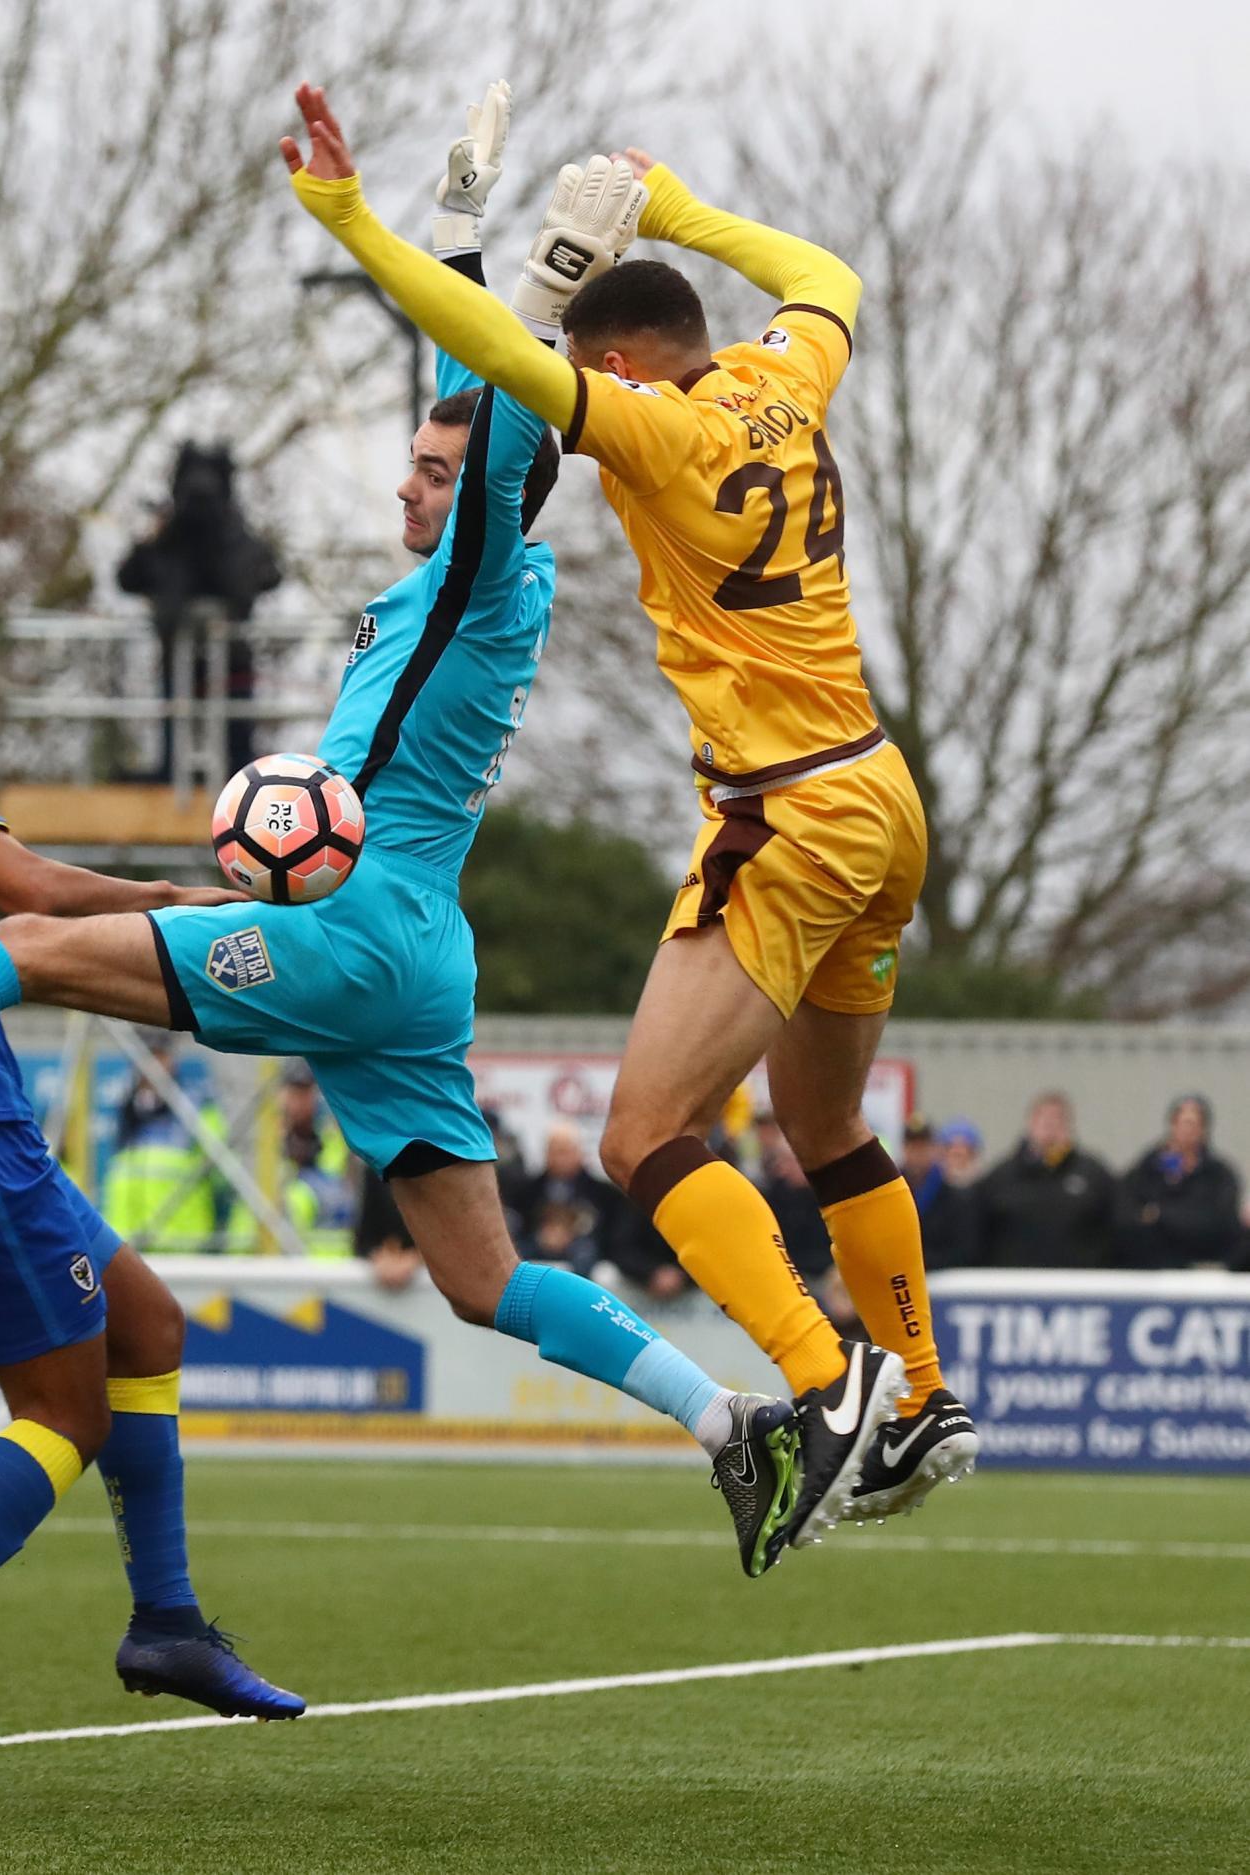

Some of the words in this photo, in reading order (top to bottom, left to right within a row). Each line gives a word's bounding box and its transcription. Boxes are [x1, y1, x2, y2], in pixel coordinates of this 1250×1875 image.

[712, 429, 846, 611] 24
[238, 933, 269, 981] DFTBA
[590, 1295, 656, 1344] WIMBLE
[890, 1274, 921, 1338] SUFC
[945, 1304, 1111, 1367] TIME
[1127, 1305, 1250, 1368] CAT
[984, 1371, 1090, 1418] your
[1150, 1418, 1250, 1459] Sutto
